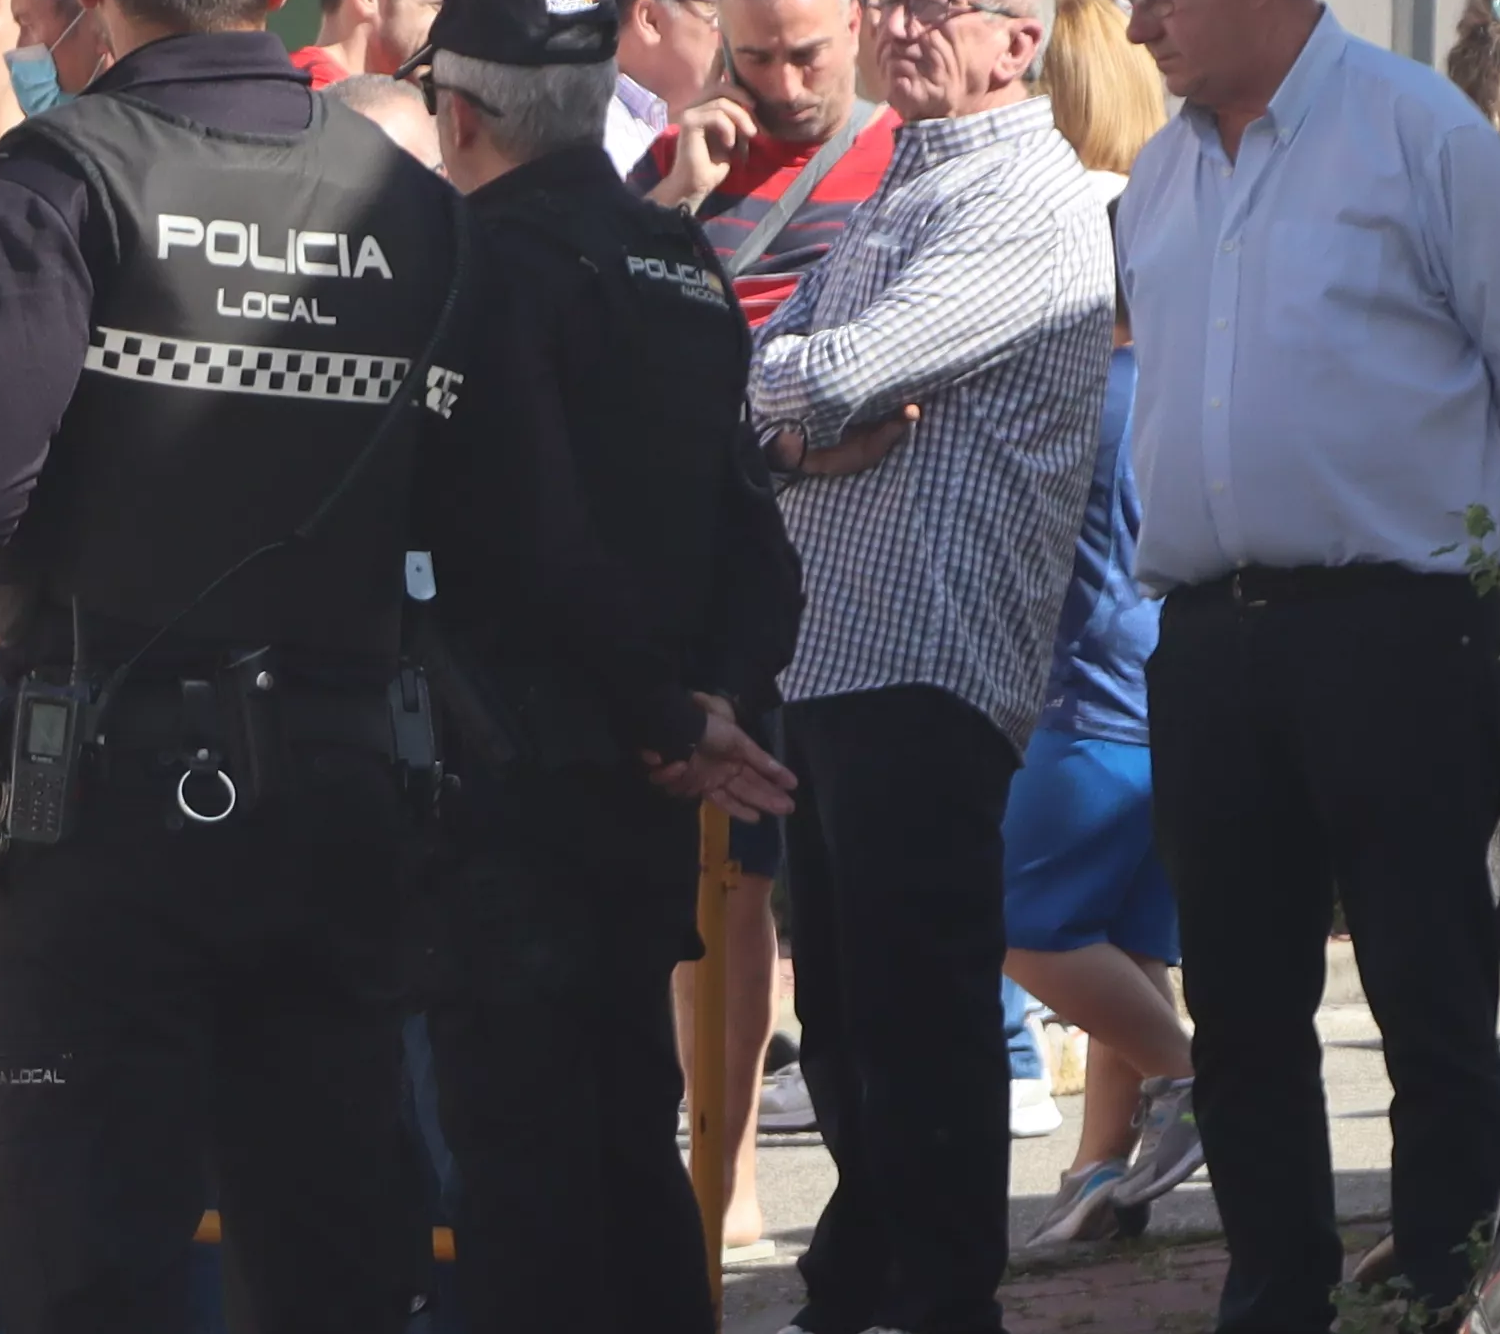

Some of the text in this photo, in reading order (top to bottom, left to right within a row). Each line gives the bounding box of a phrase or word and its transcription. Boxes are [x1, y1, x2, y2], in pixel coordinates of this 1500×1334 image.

[157, 214, 394, 279] POLICIA
[216, 288, 337, 325] LOCAL
[10, 1068, 66, 1085] LOCAL
